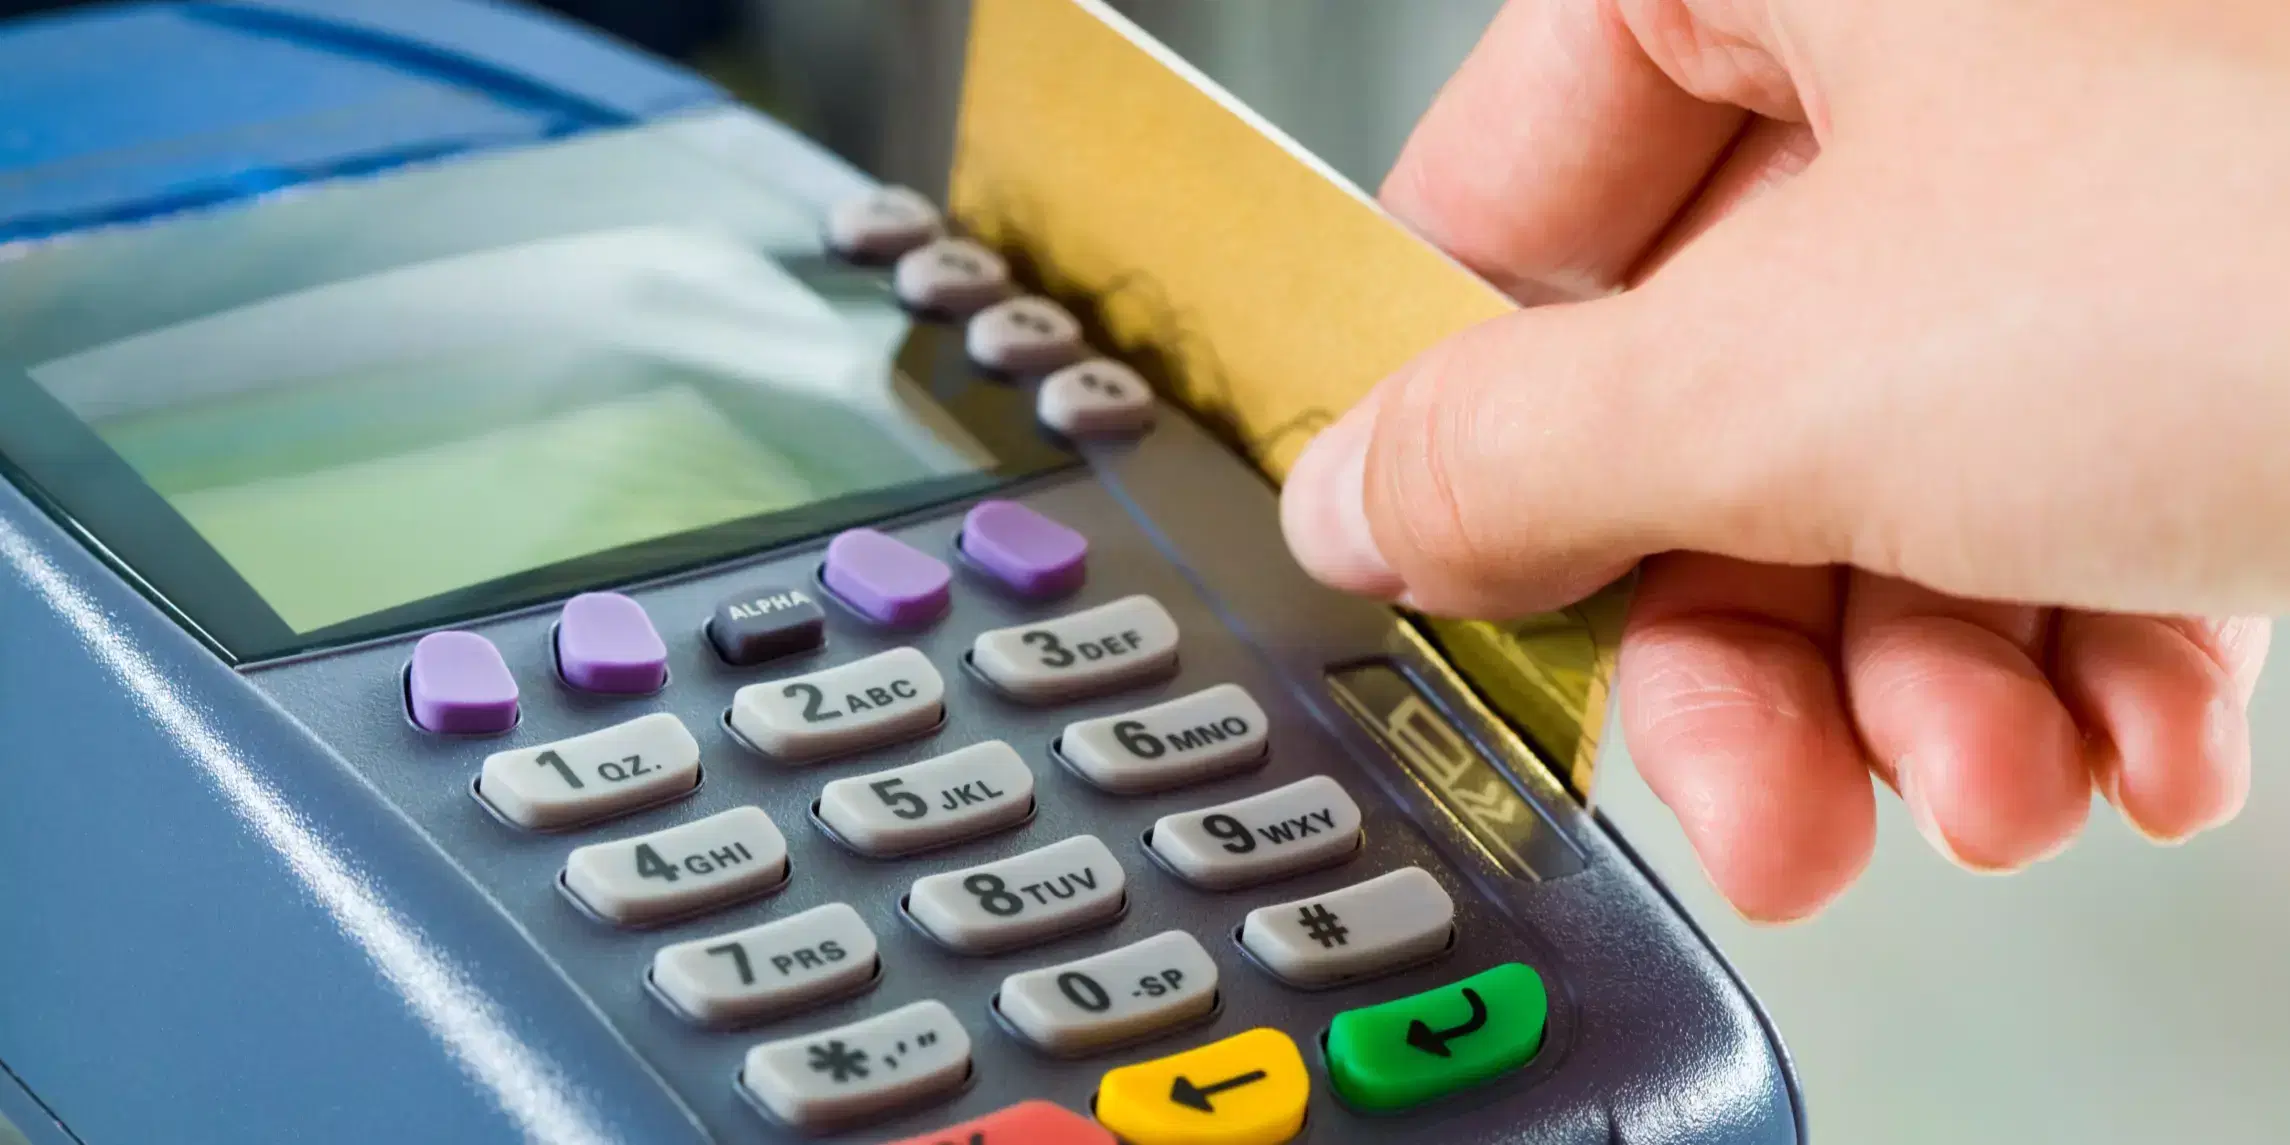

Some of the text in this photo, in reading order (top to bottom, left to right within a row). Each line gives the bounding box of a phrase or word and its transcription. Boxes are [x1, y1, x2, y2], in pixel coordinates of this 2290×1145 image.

[728, 589, 811, 621] ALPHA
[1022, 629, 1144, 668] 3 DEF
[782, 679, 918, 724] 2 ABC
[1112, 716, 1249, 760] 6 MNO
[535, 749, 585, 790] 1
[868, 777, 1004, 820] 5 JKL
[1202, 808, 1337, 854] 9 WXY
[634, 841, 753, 882] 4 GHI
[962, 867, 1097, 917] 8 TUV
[706, 940, 846, 986] 7 PRS
[1056, 971, 1111, 1013] 0
